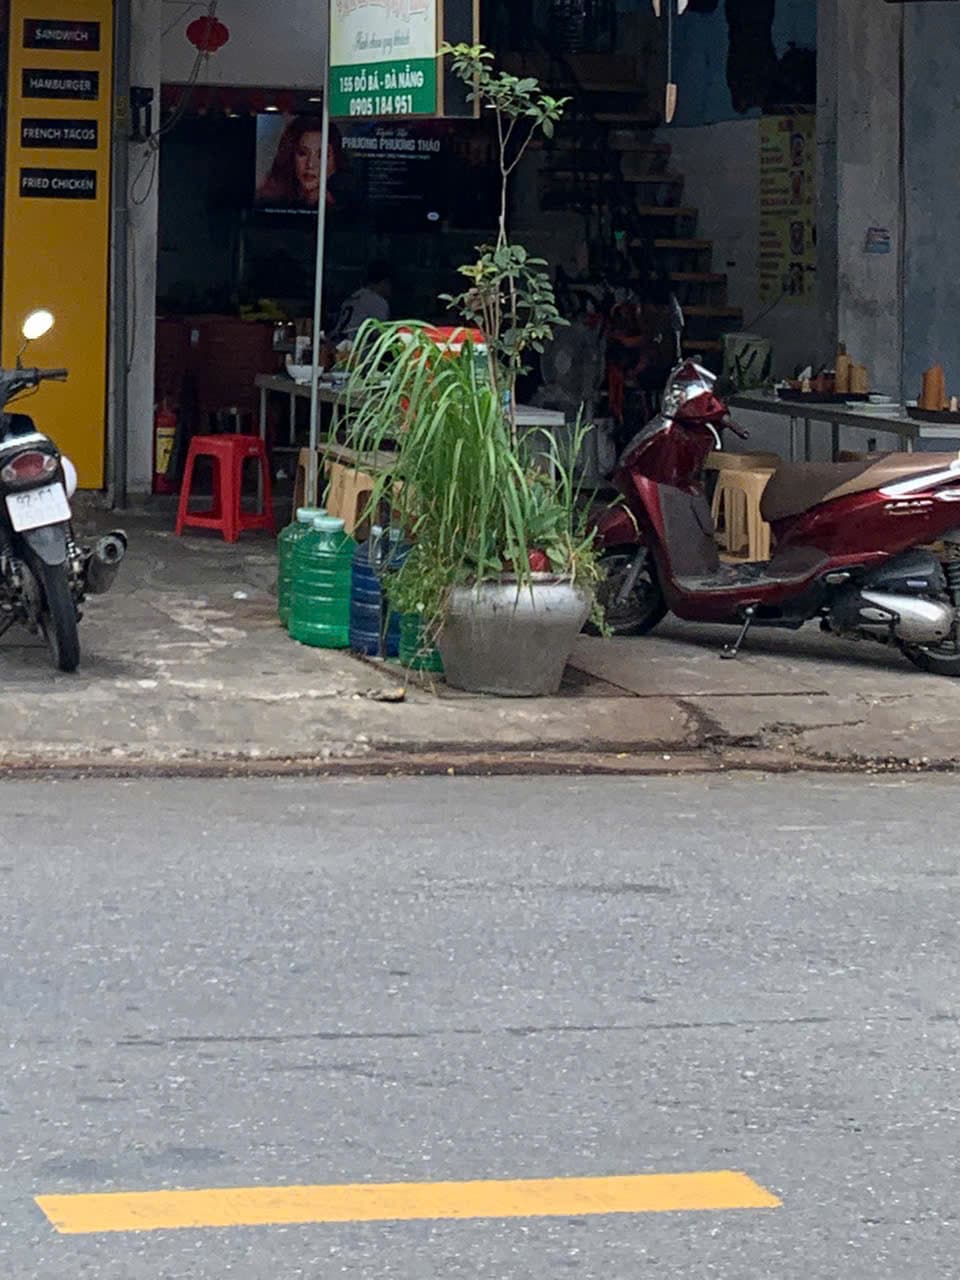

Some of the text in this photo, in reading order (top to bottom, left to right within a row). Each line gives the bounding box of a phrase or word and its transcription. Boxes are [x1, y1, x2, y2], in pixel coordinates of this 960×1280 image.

[34, 28, 89, 41] SANDWICH
[29, 78, 92, 91] HAMBURGER
[340, 76, 353, 93] 155
[368, 70, 380, 91] BÁ
[385, 69, 397, 90] ĐÀ
[349, 94, 413, 117] 0905 184 951
[23, 127, 96, 141] FRENCH TACOS
[22, 176, 94, 191] FRIED CHICKEN
